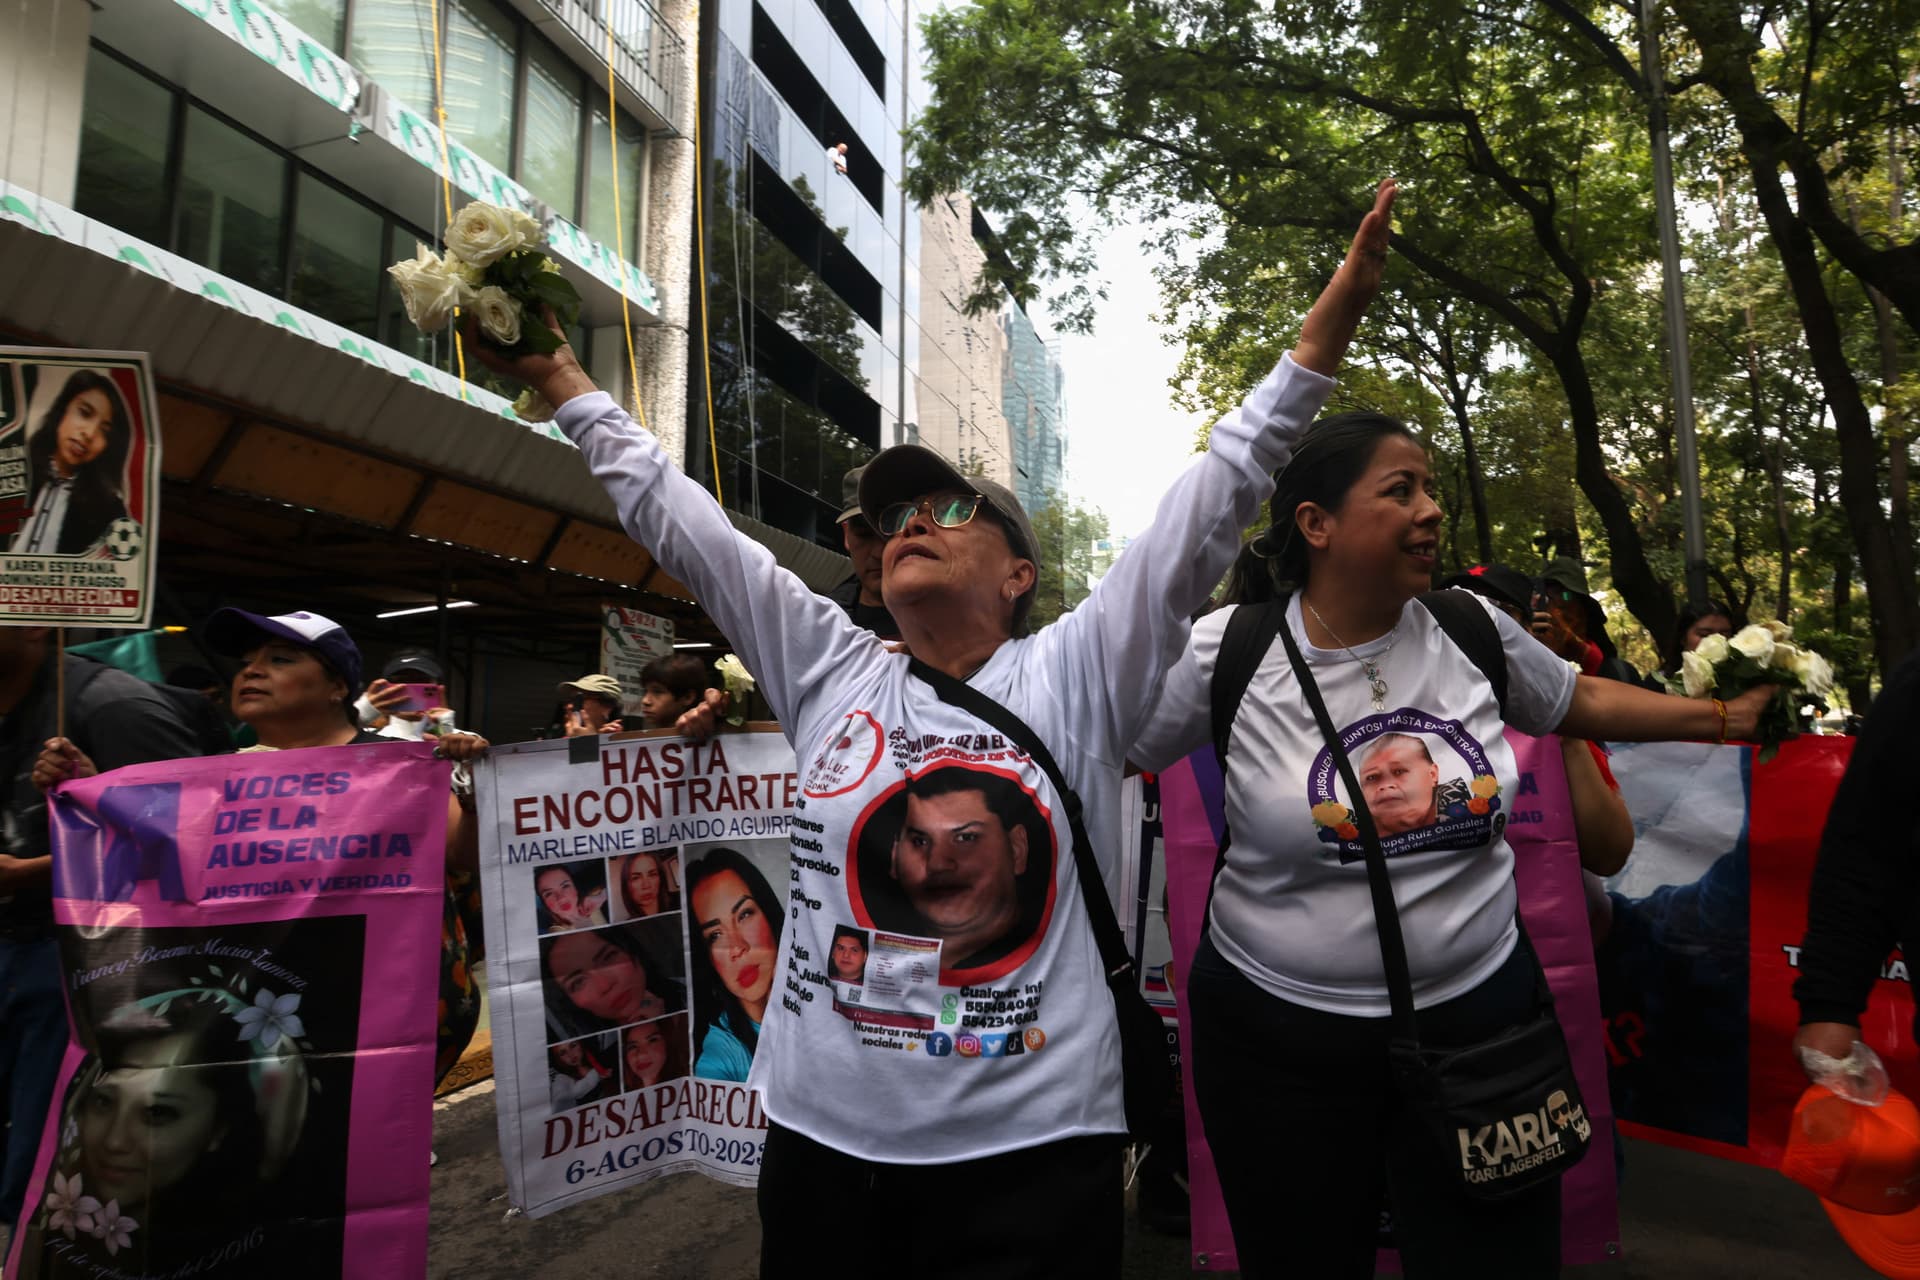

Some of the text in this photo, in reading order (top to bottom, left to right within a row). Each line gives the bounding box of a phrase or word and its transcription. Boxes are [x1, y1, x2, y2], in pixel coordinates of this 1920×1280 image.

[0, 588, 125, 605] DESAPARECIDA
[948, 734, 973, 749] LUZ
[1342, 722, 1383, 747] JUNTOS!
[1387, 715, 1422, 729] HASTA
[602, 739, 730, 786] HASTA
[224, 771, 352, 803] VOCES
[513, 772, 798, 836] ENCONTRARTE
[214, 805, 317, 836] DE LA
[1407, 829, 1433, 841] Ruiz
[206, 833, 413, 869] AUSENCIA
[508, 829, 636, 865] MARLENNE
[641, 818, 724, 847] BLANDO
[201, 873, 412, 900] JUSTICIA Y VERDAD
[853, 1021, 900, 1037] Nuestras
[861, 1036, 904, 1051] sociales
[1457, 1105, 1560, 1170] KARL
[1464, 1166, 1501, 1184] KARL
